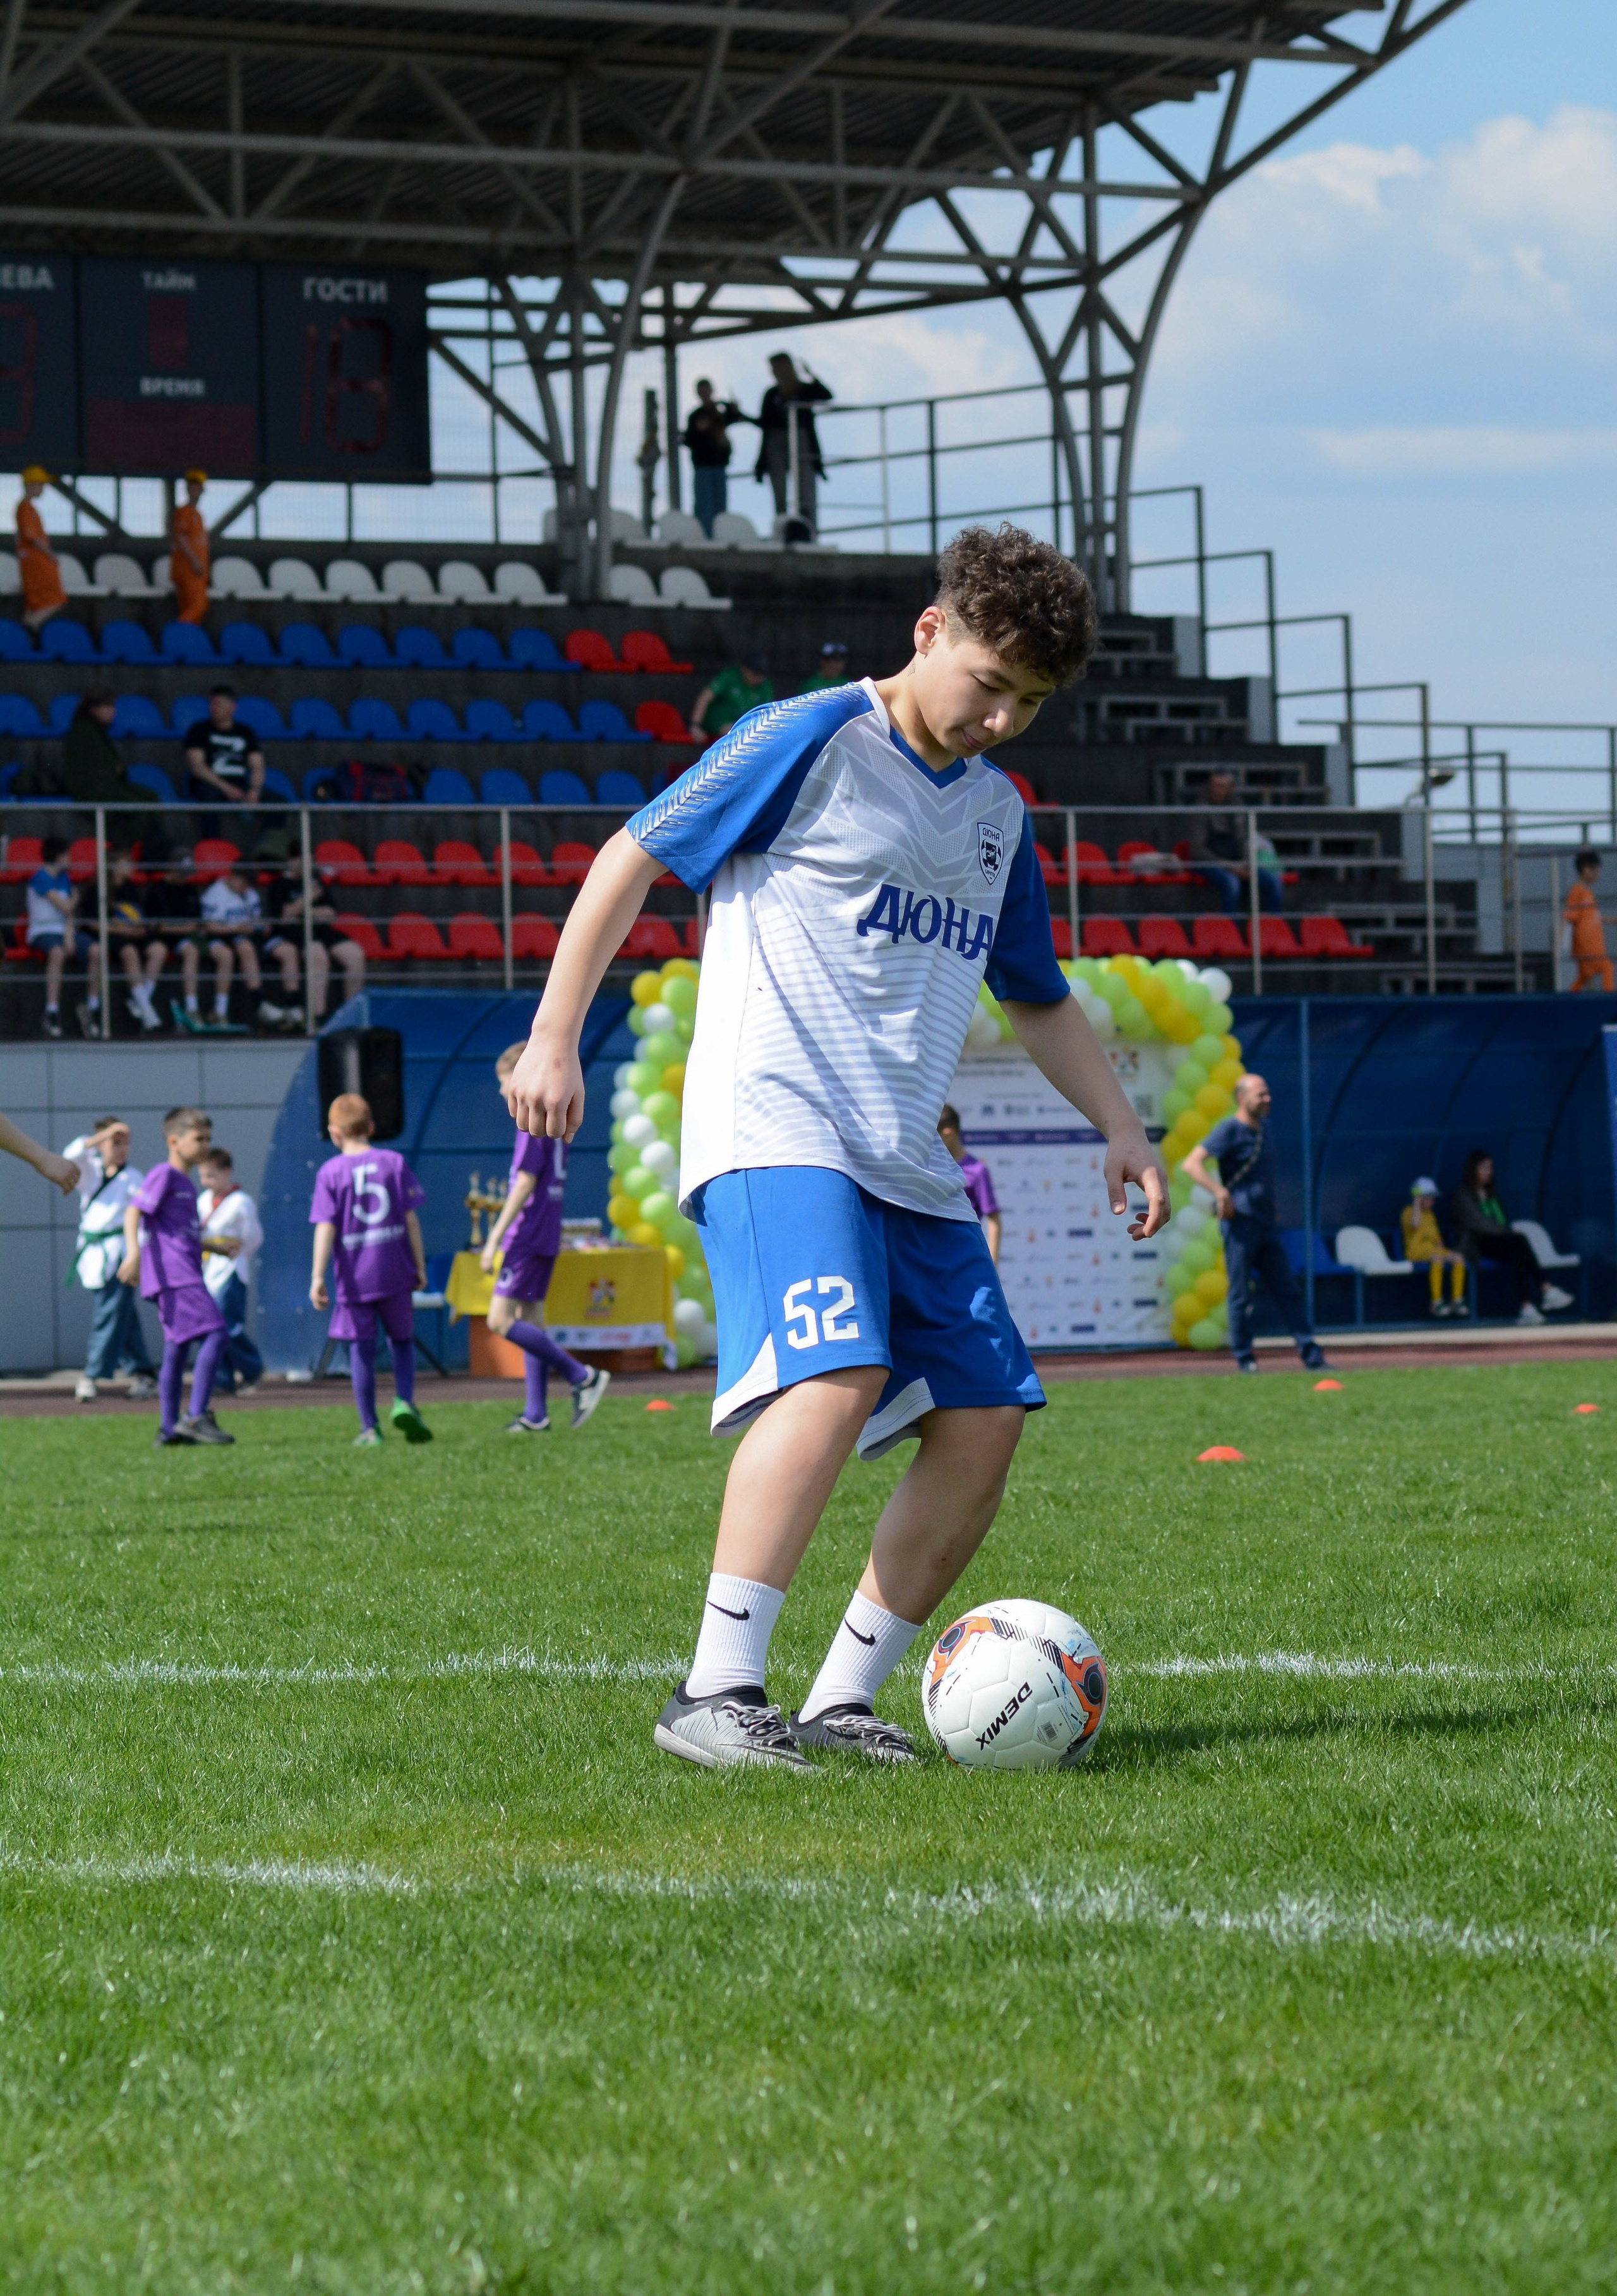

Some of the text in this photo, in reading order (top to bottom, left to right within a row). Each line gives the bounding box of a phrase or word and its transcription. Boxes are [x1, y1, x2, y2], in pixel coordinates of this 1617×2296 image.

[303, 277, 388, 302] ГОСТИ
[140, 377, 205, 396] ВРЕМЯ
[982, 827, 1000, 842] ДЮНА
[857, 883, 994, 961] ДЮНА
[352, 1163, 391, 1224] 5
[783, 1275, 860, 1350] 52
[975, 1681, 1033, 1751] DEMIX
